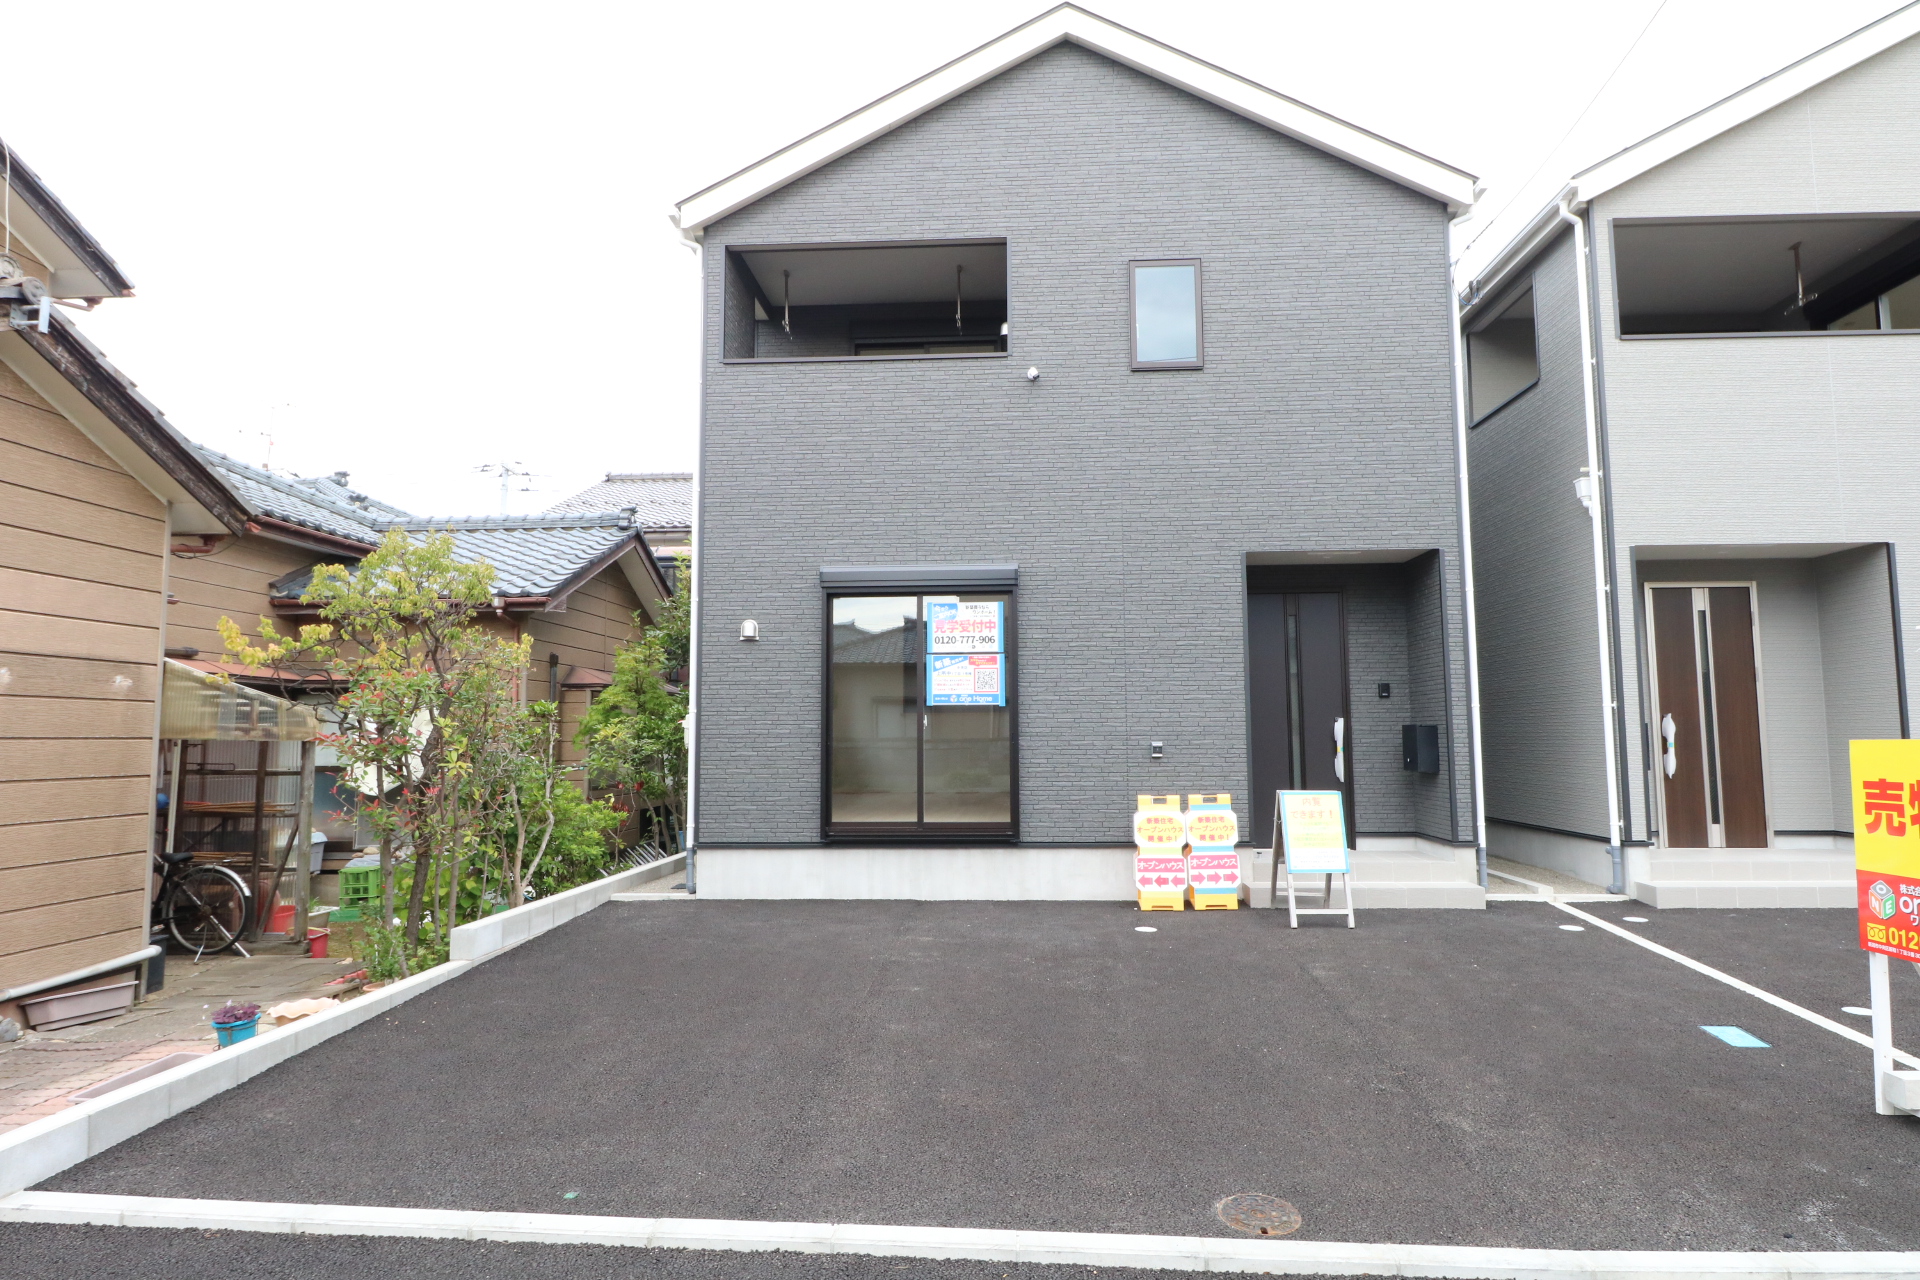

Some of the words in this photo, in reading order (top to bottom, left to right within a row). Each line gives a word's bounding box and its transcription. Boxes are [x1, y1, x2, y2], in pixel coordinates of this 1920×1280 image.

[934, 619, 996, 633] 見学受付中
[934, 635, 996, 644] 0120-777-906
[1863, 778, 1920, 838] 売
[1146, 817, 1174, 825] 新築住宅
[1197, 816, 1225, 824] 新築住宅
[1137, 861, 1184, 870] オープンハウス
[1190, 858, 1238, 867] オープンハウス
[1888, 927, 1920, 950] 012
